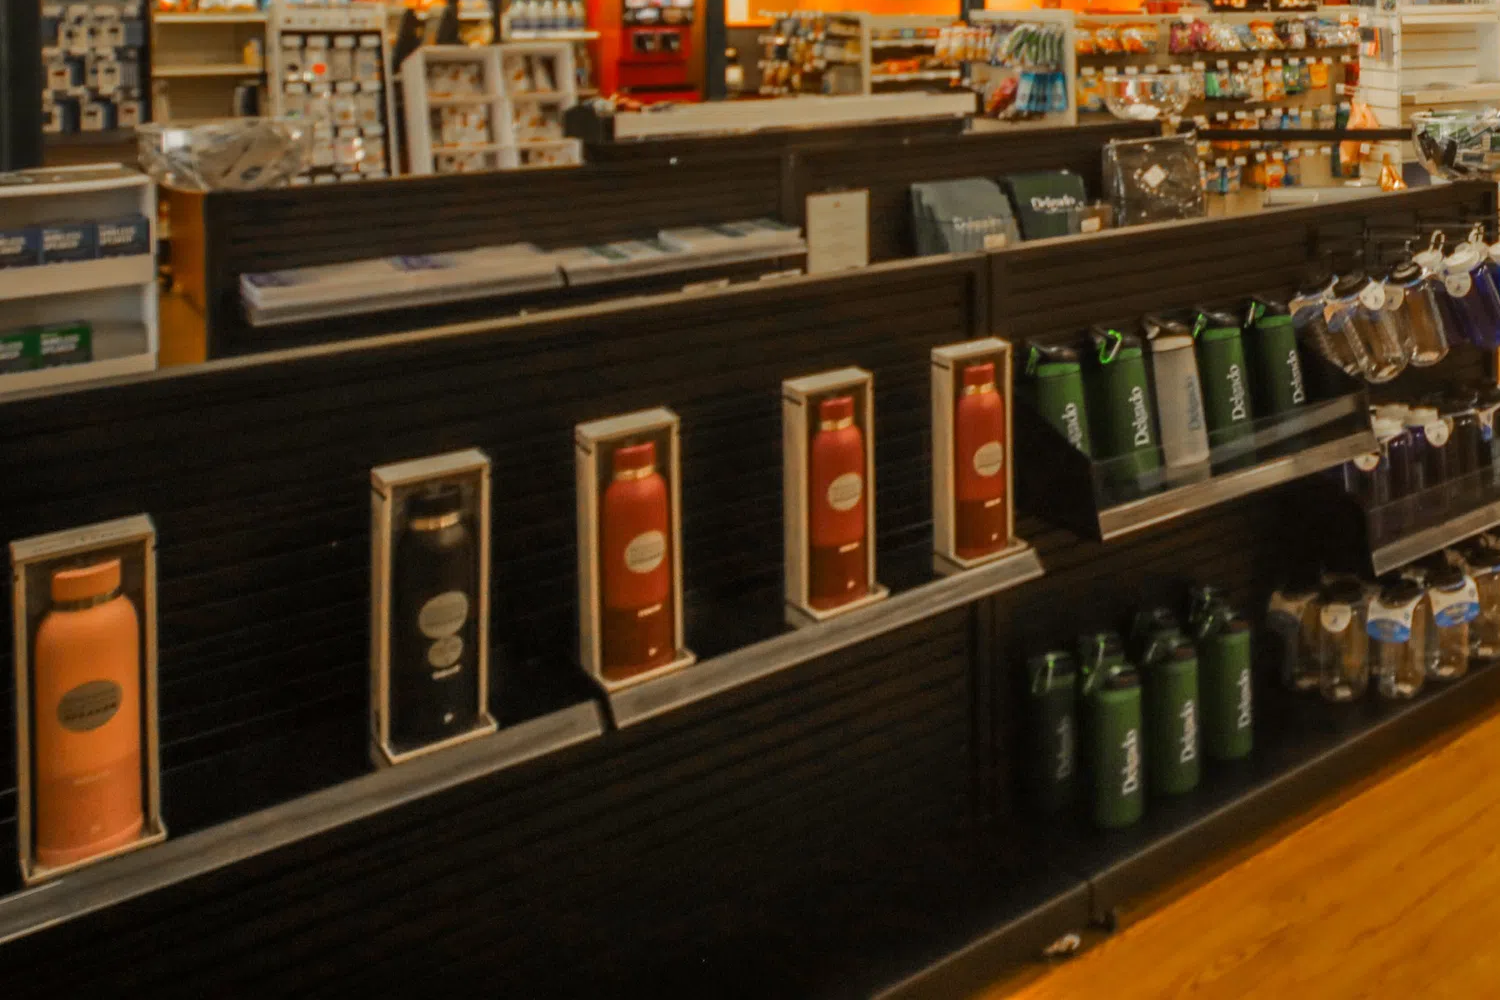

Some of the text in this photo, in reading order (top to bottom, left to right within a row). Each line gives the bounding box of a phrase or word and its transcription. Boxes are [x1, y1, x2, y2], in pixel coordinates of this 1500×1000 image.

[1127, 385, 1150, 447] Delgado
[1226, 364, 1246, 421] Delgado
[1121, 727, 1140, 796] Delgado
